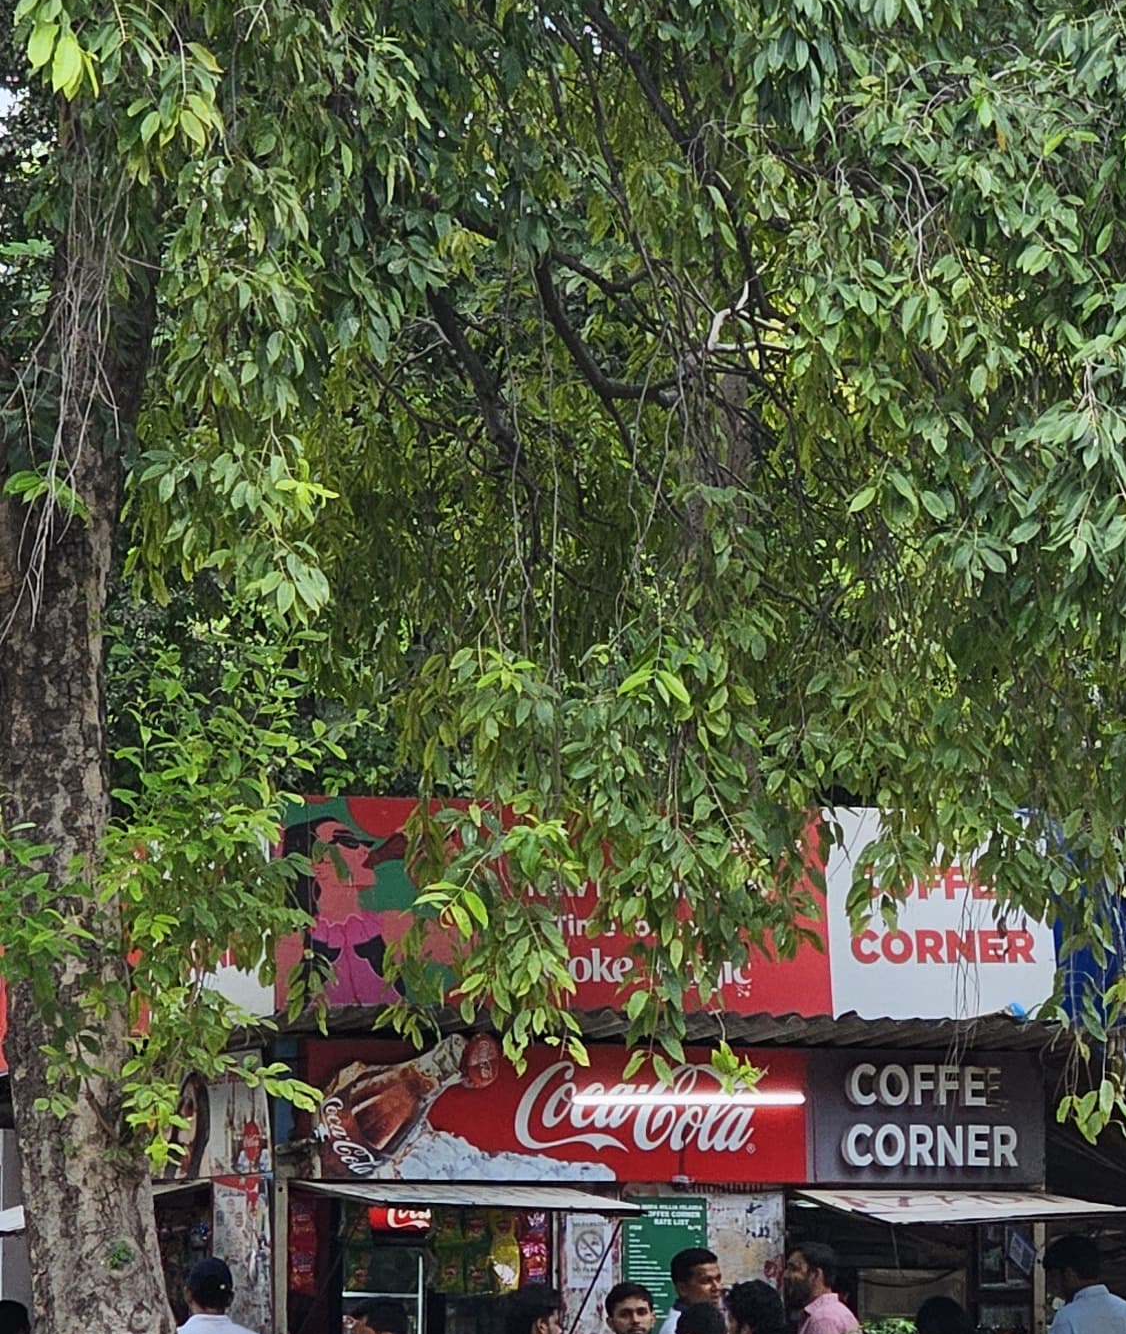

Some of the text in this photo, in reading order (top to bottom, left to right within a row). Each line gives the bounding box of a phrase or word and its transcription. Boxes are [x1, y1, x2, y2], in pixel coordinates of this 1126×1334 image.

[567, 948, 634, 983] oke
[851, 928, 1037, 965] CORNER
[514, 1061, 762, 1153] Coca-Cola
[841, 1123, 1019, 1167] CORNER
